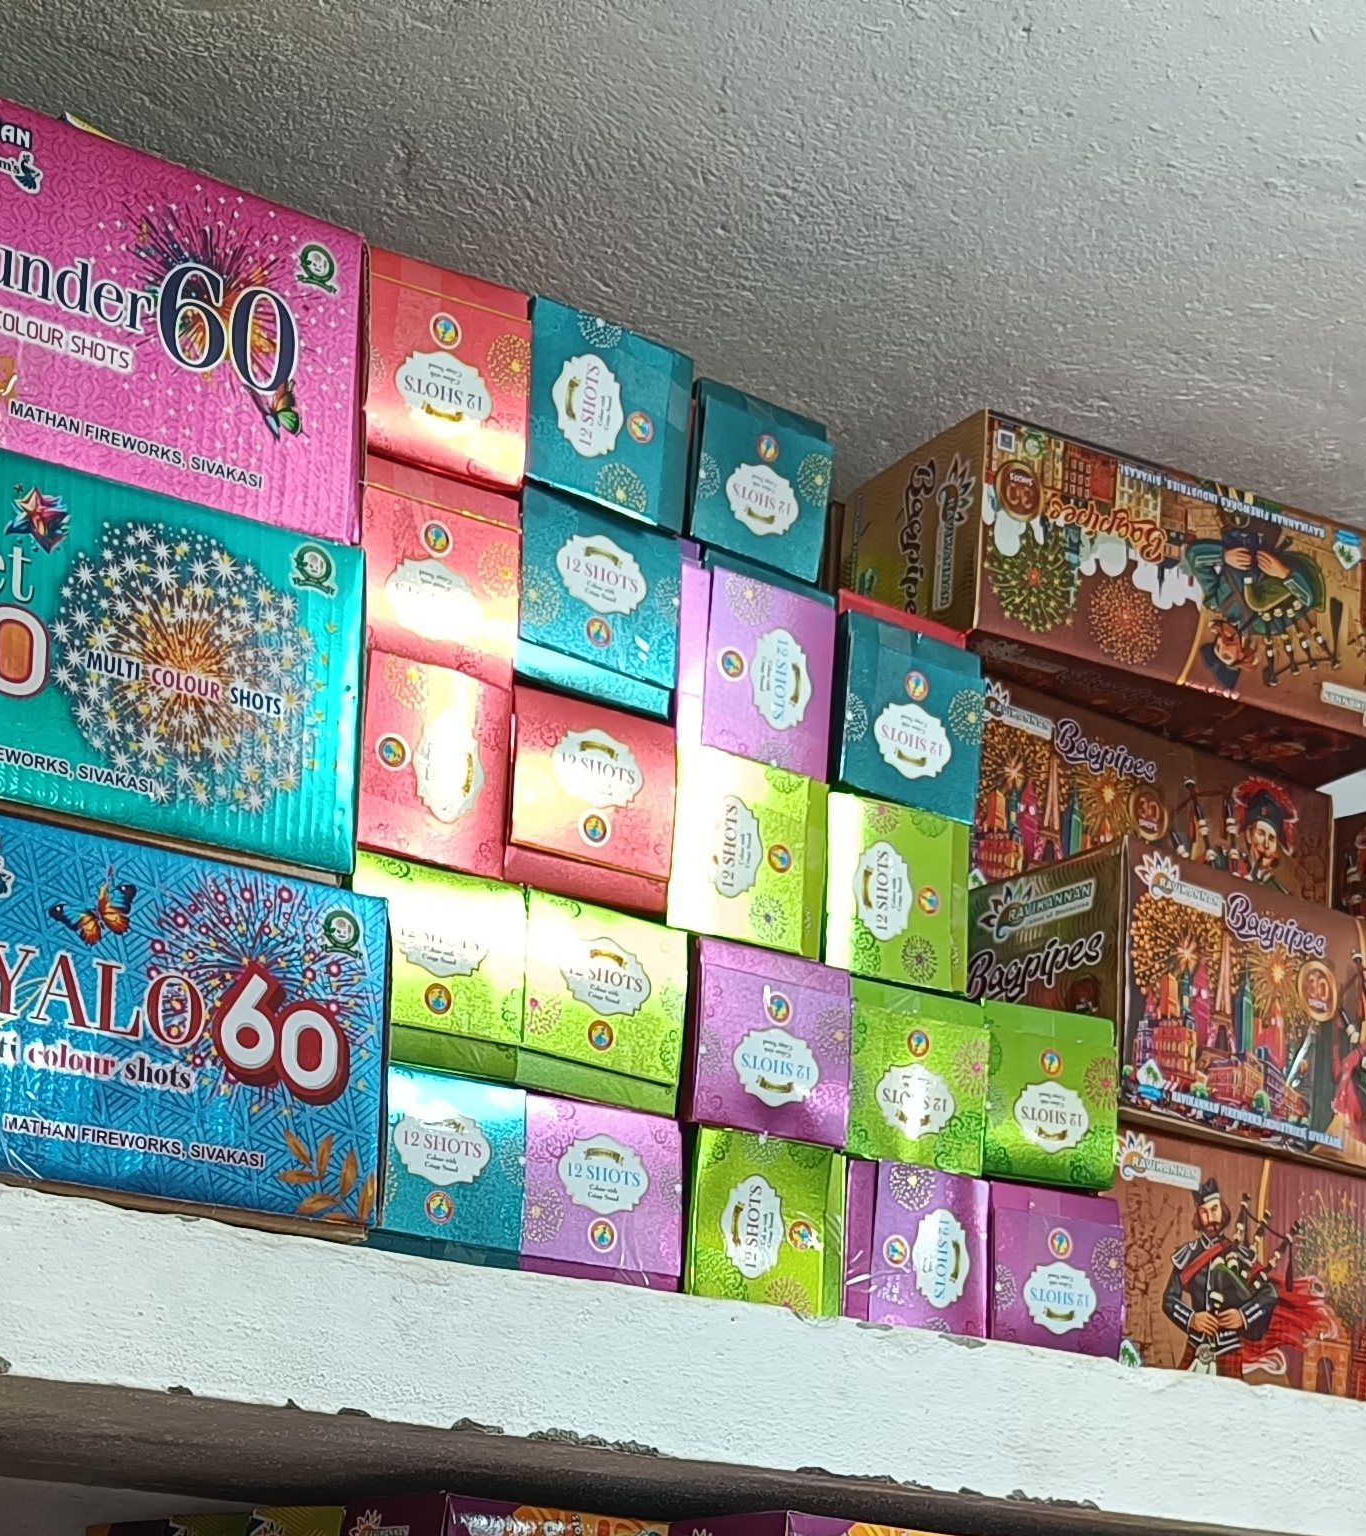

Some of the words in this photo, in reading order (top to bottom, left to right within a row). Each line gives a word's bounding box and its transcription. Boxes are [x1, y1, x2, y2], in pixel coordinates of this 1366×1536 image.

[156, 262, 296, 395] 60
[69, 328, 132, 371] SHOTS
[403, 374, 461, 405] SHOTS
[462, 391, 485, 411] 12
[580, 363, 601, 415] SHOTS
[9, 400, 80, 434] MATHAN
[83, 420, 186, 468] FIREWORKS,
[189, 454, 264, 489] SIVAKASI
[578, 418, 593, 447] 12
[564, 555, 585, 574] 12
[587, 558, 639, 595] SHOTS
[86, 648, 142, 684] MULTI
[149, 663, 221, 702] COLOUR
[228, 684, 283, 717] SHOTS
[1055, 718, 1157, 782] Bagpipes
[77, 762, 156, 796] SIVAKASI
[1226, 892, 1327, 959] Bagpipes
[967, 931, 1103, 1001] Bagpipes
[212, 963, 350, 1105] 60
[22, 1040, 115, 1079] colour
[123, 1057, 193, 1093] shots
[741, 1048, 787, 1076] SHOTS
[790, 1056, 812, 1081] 12
[1021, 1100, 1063, 1125] SHOTS
[1064, 1106, 1083, 1127] 12
[3, 1112, 77, 1144] MATHAN
[80, 1124, 185, 1160] FIREWORKS,
[188, 1138, 266, 1169] SIVAKASI
[400, 1128, 423, 1148] 12
[426, 1131, 483, 1161] SHOTS
[564, 1162, 586, 1181] 12
[588, 1164, 642, 1189] SHOTS
